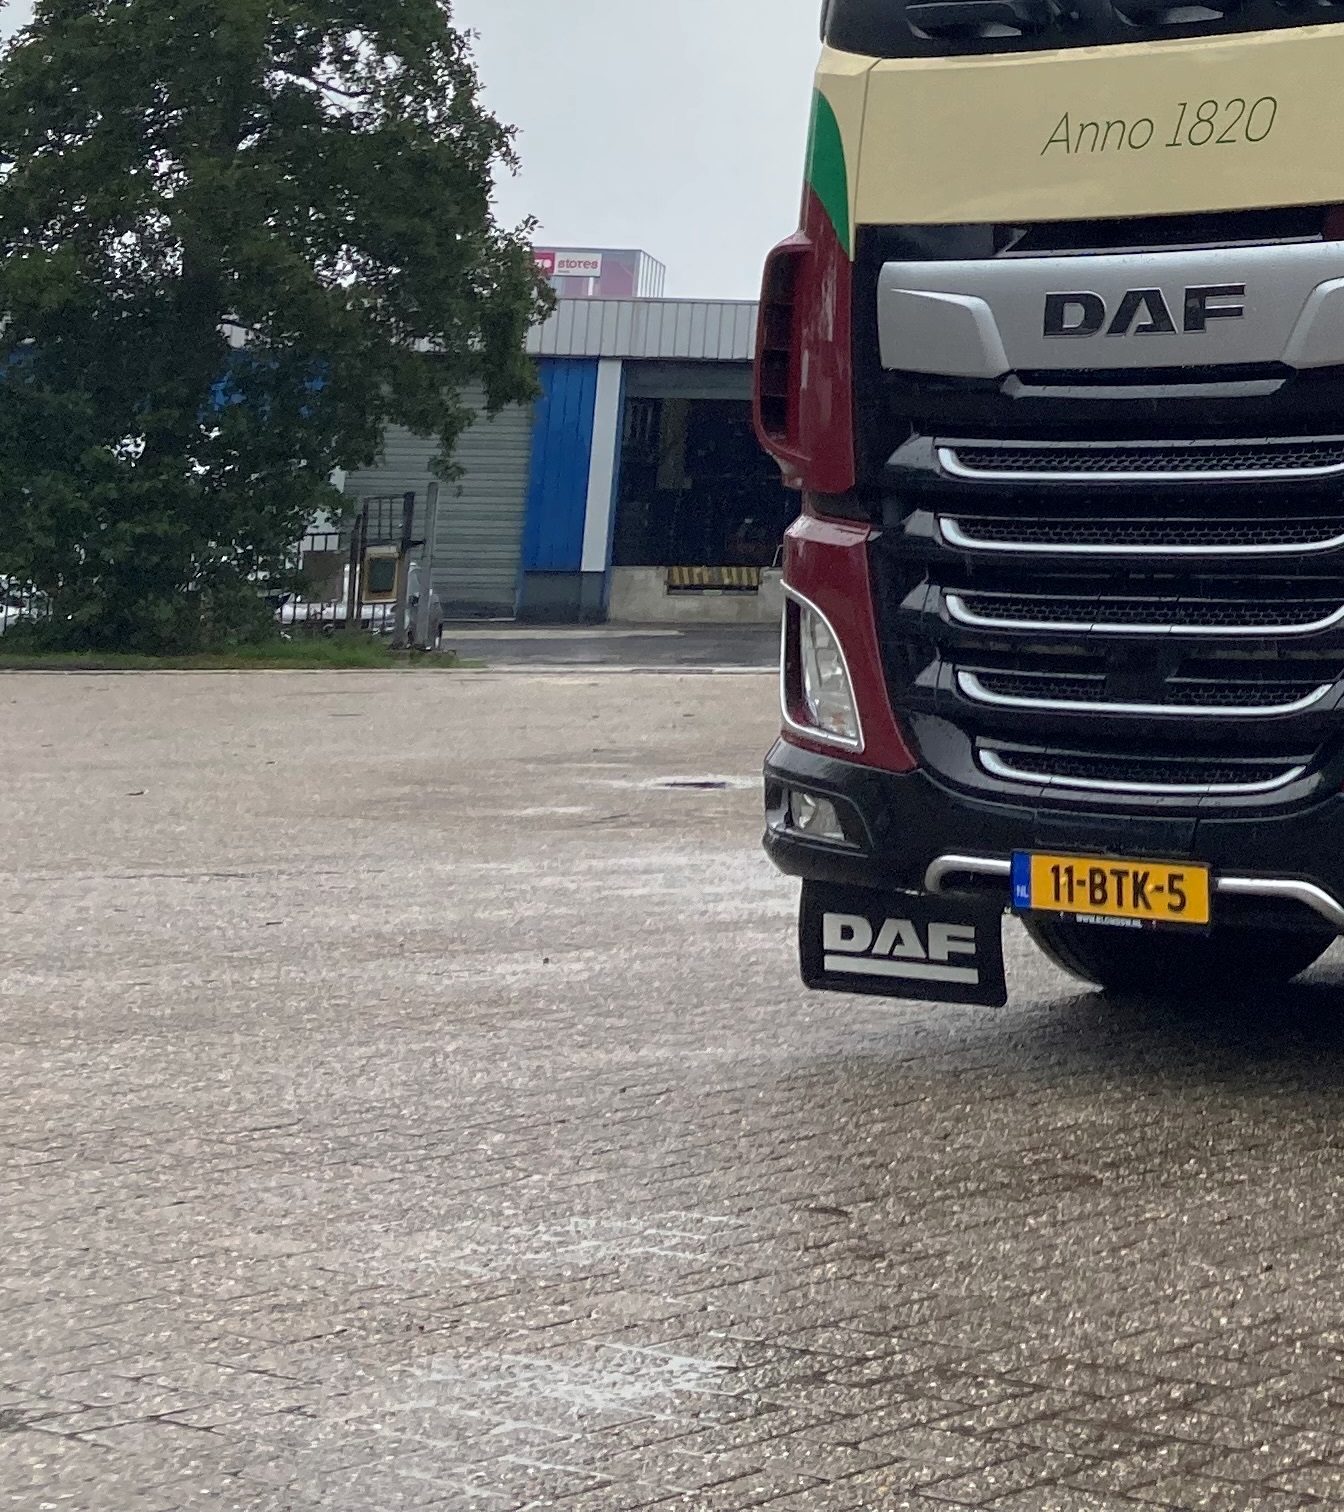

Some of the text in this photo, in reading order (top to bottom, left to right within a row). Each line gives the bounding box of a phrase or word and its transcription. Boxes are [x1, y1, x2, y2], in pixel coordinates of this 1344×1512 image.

[1040, 96, 1278, 156] Anno 1820
[557, 259, 599, 270] stores
[1043, 284, 1246, 338] DAF
[1016, 885, 1029, 899] NL
[1051, 865, 1187, 912] 11-BTK-5
[822, 911, 976, 961] DAF
